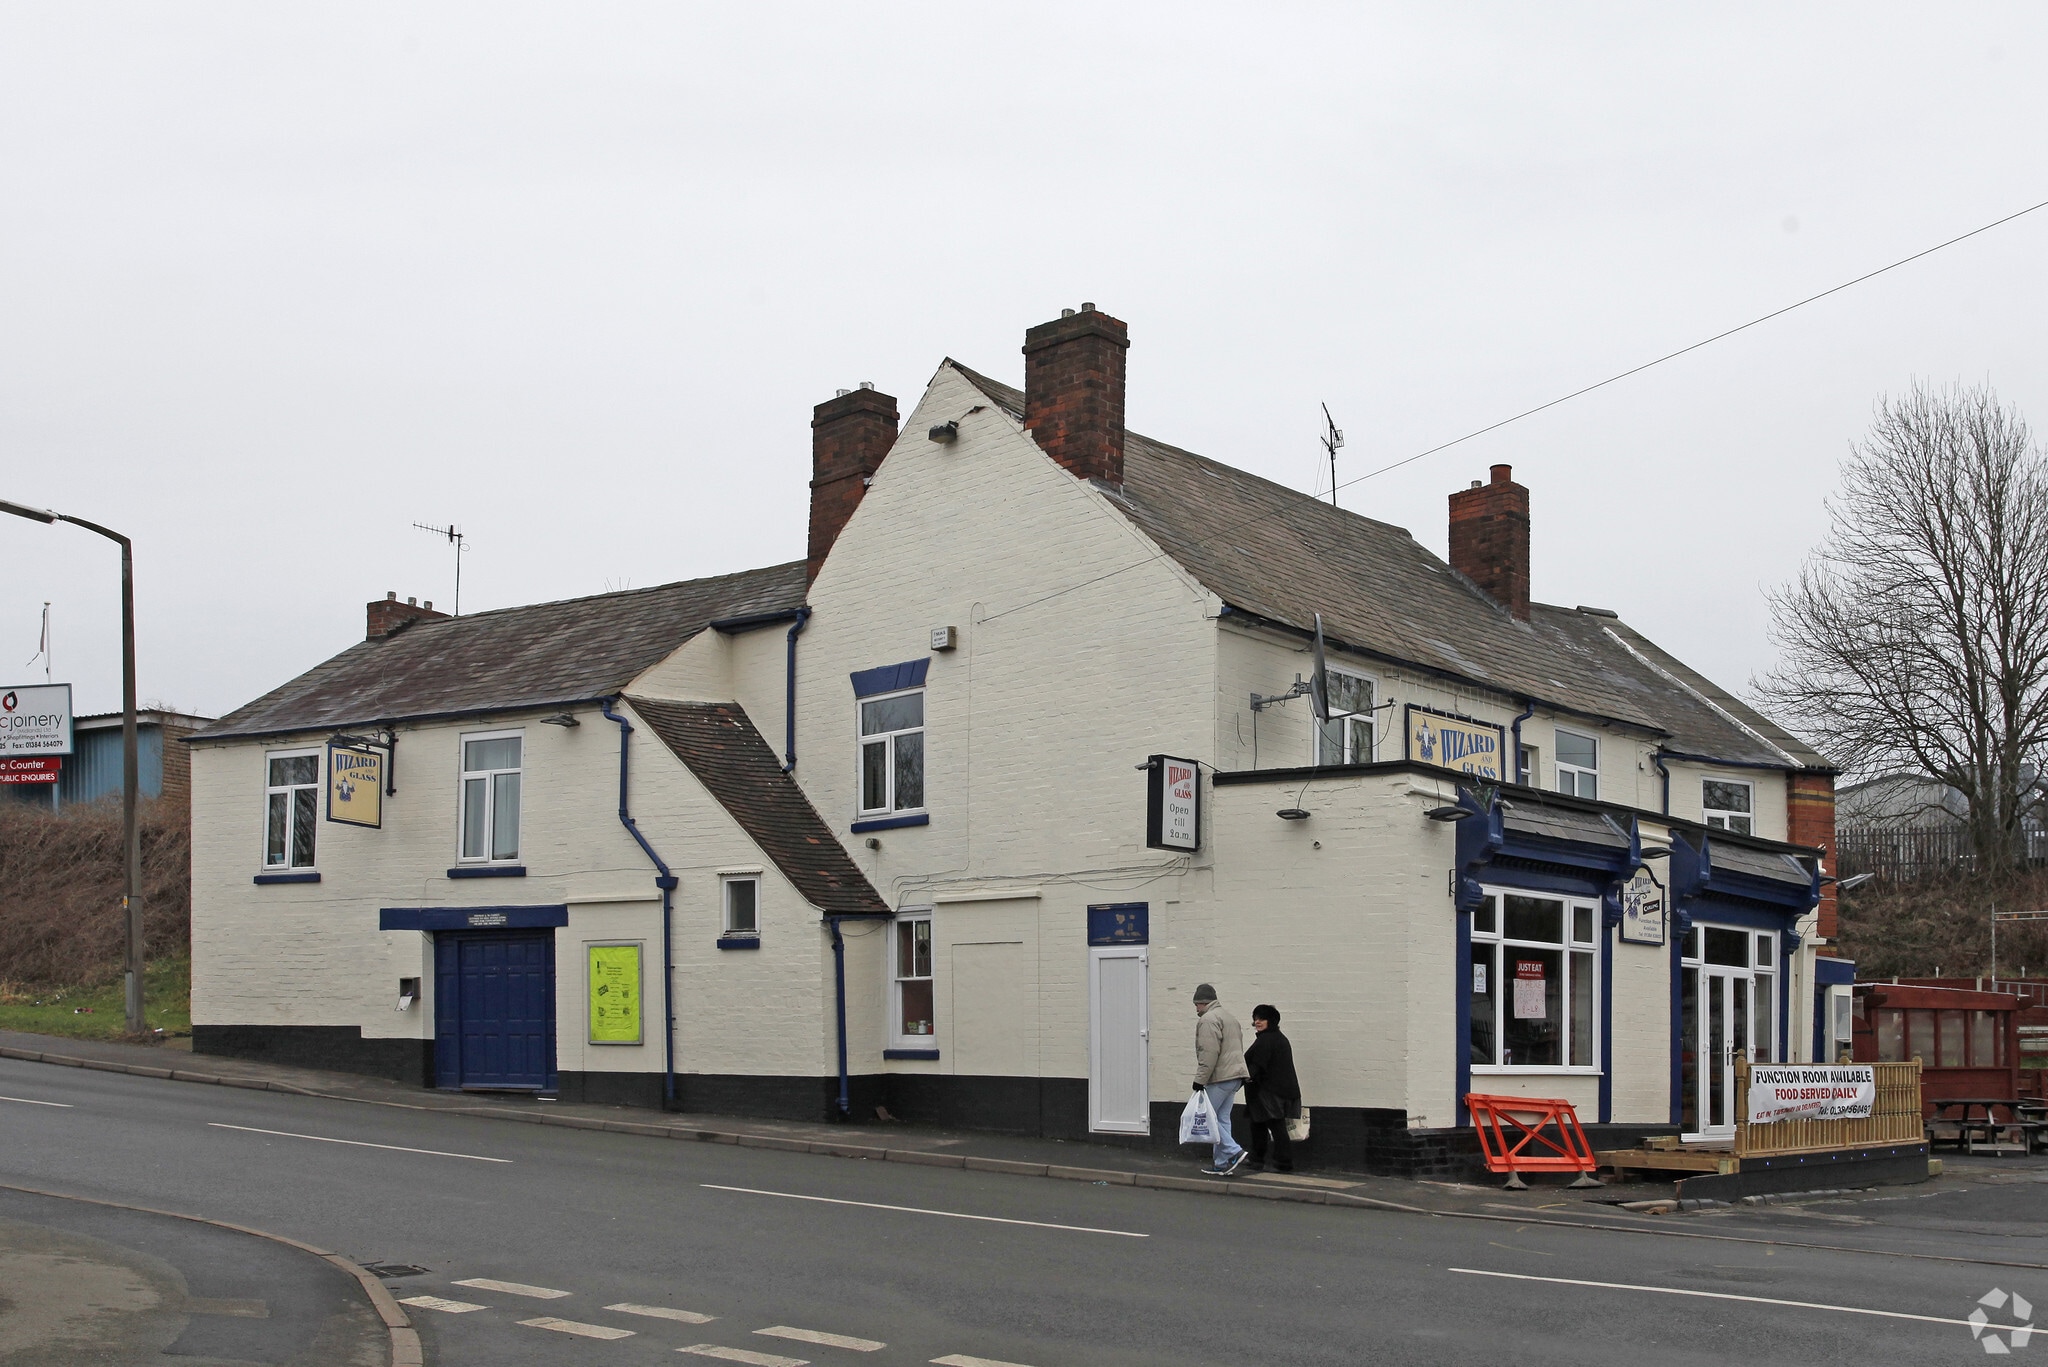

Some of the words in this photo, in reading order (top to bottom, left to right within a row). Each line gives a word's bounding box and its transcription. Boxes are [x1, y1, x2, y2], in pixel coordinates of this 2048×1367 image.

[1440, 729, 1495, 768] WIZARD
[9, 759, 45, 770] Counter
[335, 754, 376, 774] WIZARD
[1481, 755, 1493, 763] AND
[21, 773, 55, 781] ENQUIRIES
[349, 772, 376, 782] GLASS
[1168, 766, 1192, 789] WIZARD
[1174, 788, 1192, 799] GLASS
[1169, 803, 1189, 815] Open
[1174, 818, 1185, 827] till
[1169, 829, 1191, 840] 2a.m.
[1517, 963, 1531, 972] JUST
[1531, 963, 1543, 972] EAT
[1755, 1070, 1800, 1084] FUNCTION
[1802, 1070, 1828, 1083] ROOM
[1830, 1070, 1872, 1083] AVAILABLE
[1775, 1088, 1798, 1100] FOOD
[1800, 1087, 1831, 1099] SERVED
[1831, 1087, 1858, 1099] DAILY
[1756, 1111, 1765, 1119] EAT
